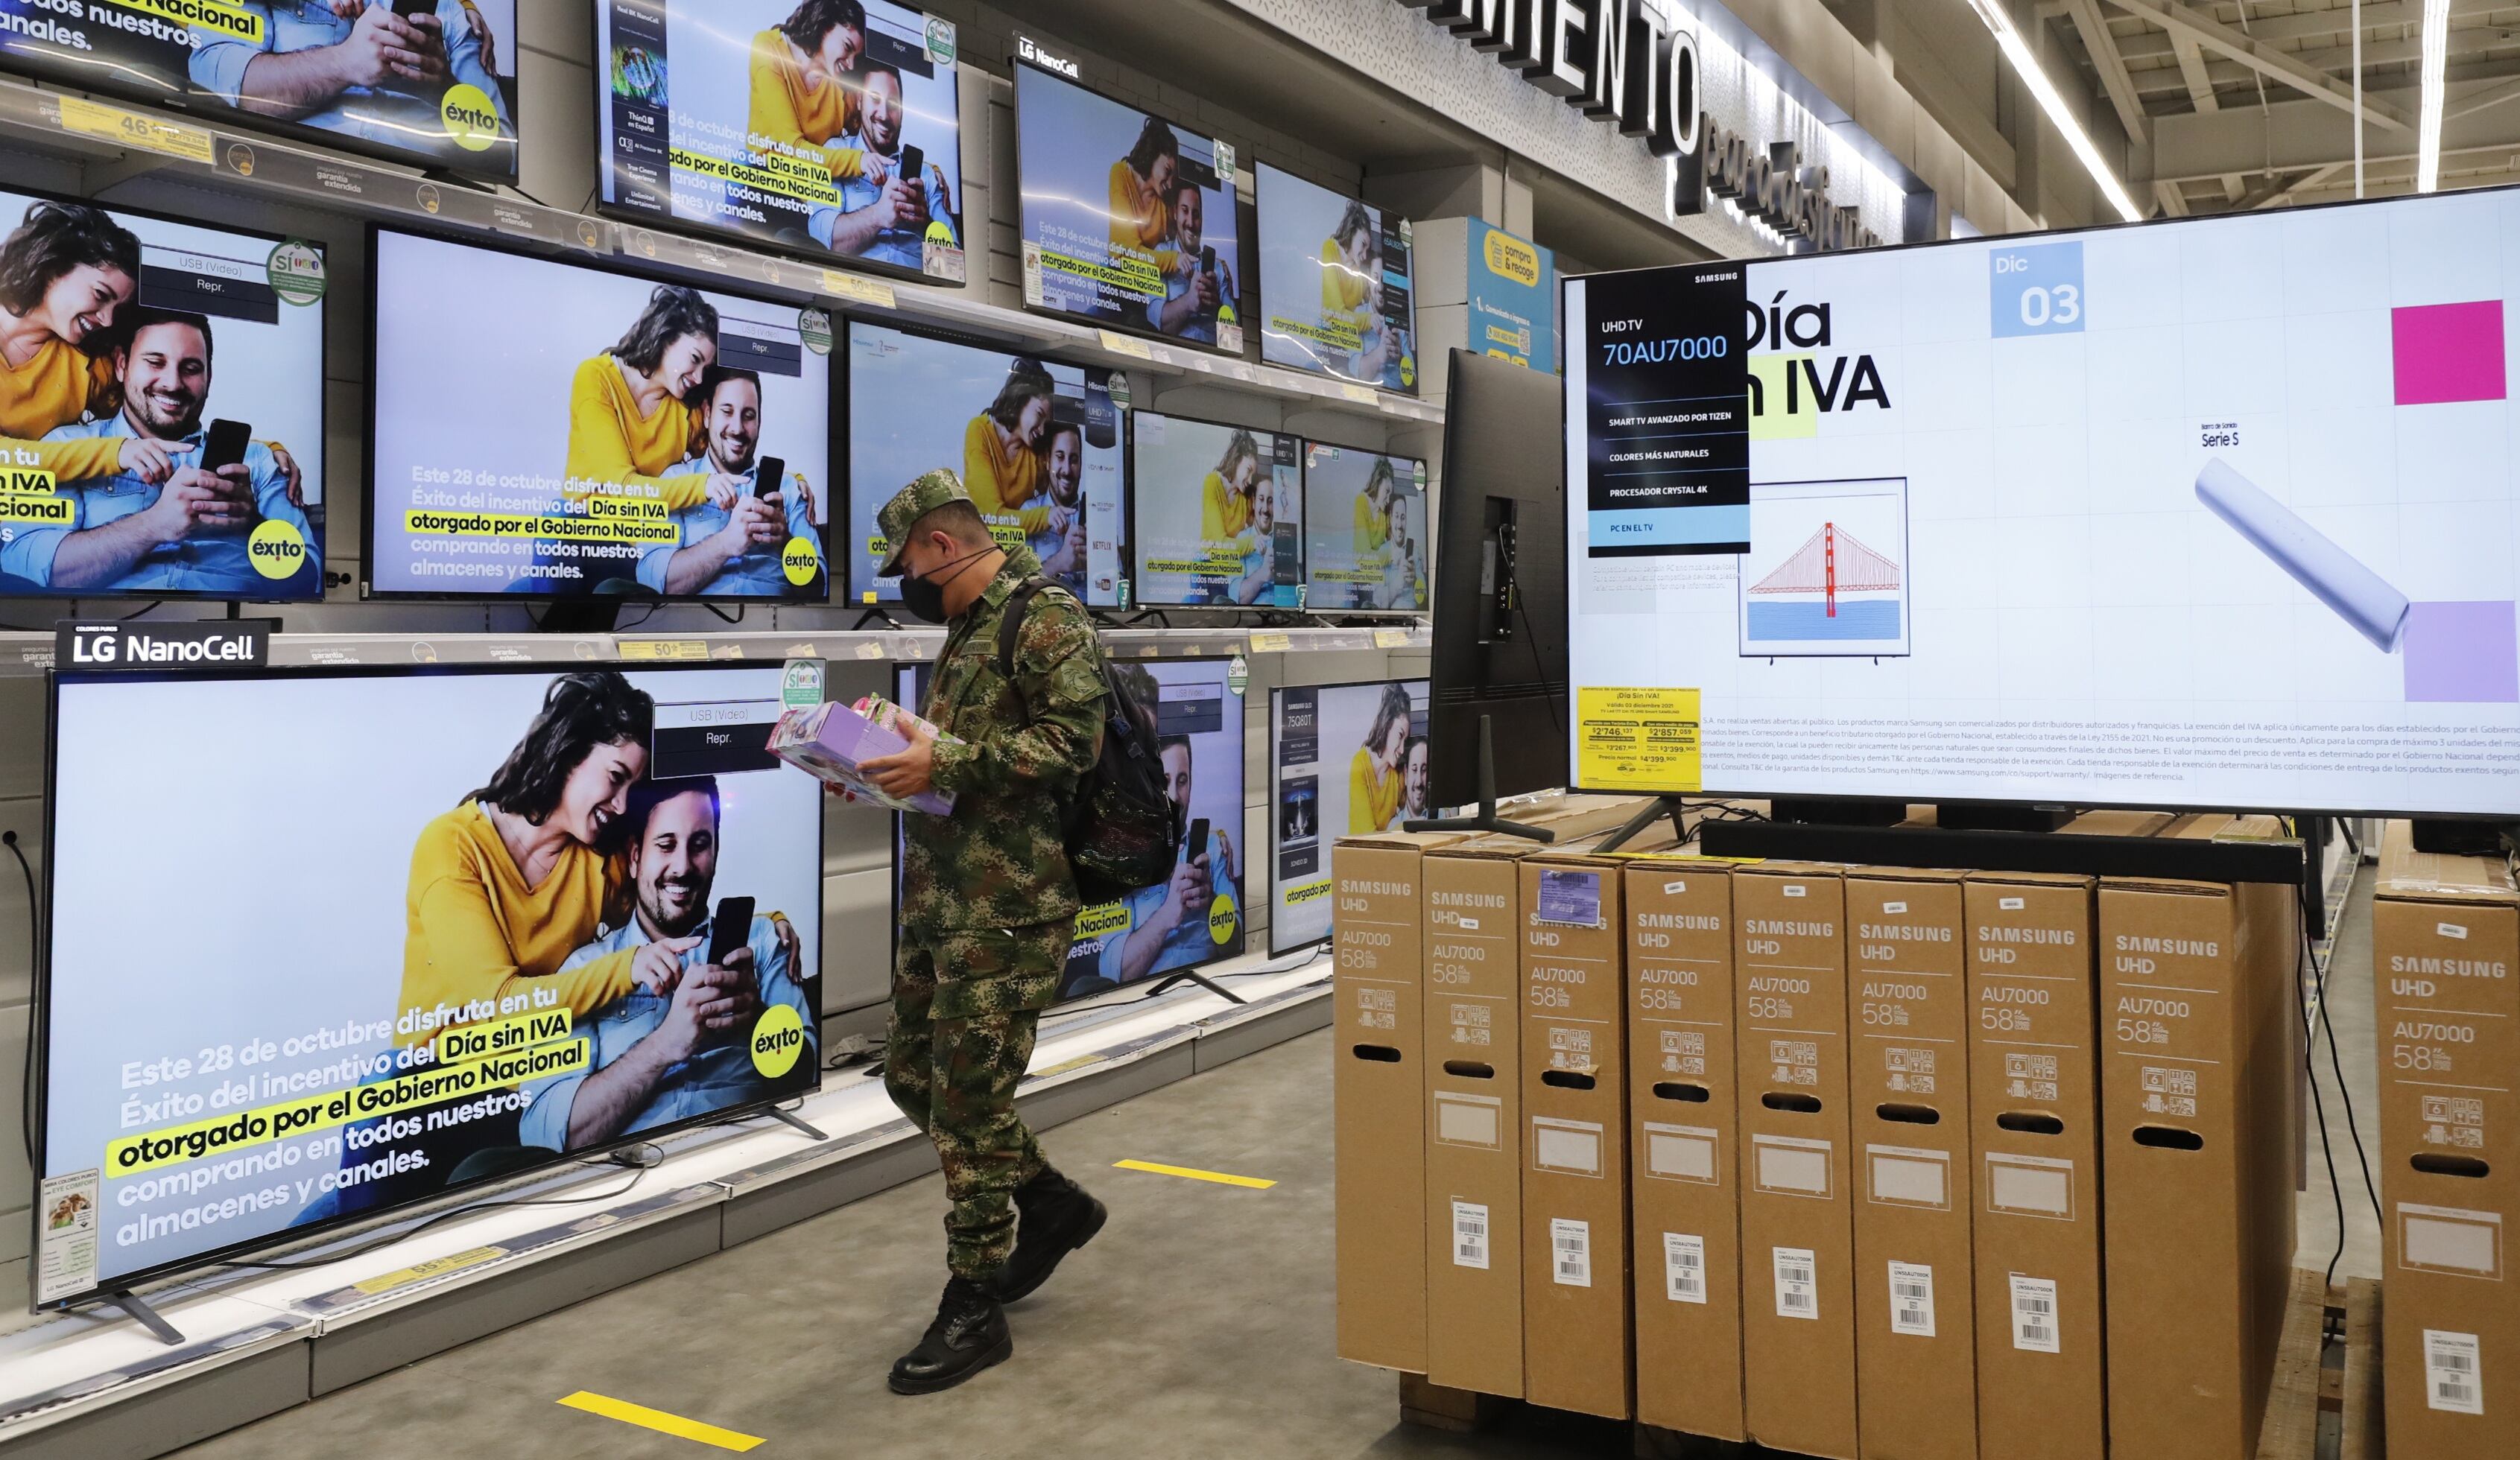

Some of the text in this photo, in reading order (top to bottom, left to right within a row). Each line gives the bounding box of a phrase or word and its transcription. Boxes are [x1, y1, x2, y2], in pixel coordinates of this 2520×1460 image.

[89, 4, 203, 49] nuestros
[151, 0, 256, 36] Nacional
[1019, 41, 1078, 78] LG NanoCell
[446, 103, 496, 131] éxito
[317, 171, 348, 183] garantía
[770, 156, 829, 182] Día sin IVA
[325, 180, 361, 193] extendida
[731, 165, 838, 203] Gobierno Nacional
[716, 202, 767, 223] canales.
[1505, 246, 1530, 264] compra
[179, 256, 243, 279] USB (Video)
[1041, 253, 1164, 293] otorgado Gobierno Nacional
[1123, 260, 1159, 279] Día sin IVA
[1505, 258, 1534, 280] & recoge
[1995, 254, 2028, 275] Dic
[197, 279, 224, 293] Repr.
[1694, 273, 1738, 283] SAMSUNG
[2020, 284, 2080, 327] 03
[1602, 319, 1643, 333] UHD TV
[752, 342, 769, 355] Repr.
[1603, 335, 1727, 366] 70AU7000
[1787, 355, 1891, 415] IVA
[1609, 412, 1732, 426] SMART TV AVANZADO POR TIZEN
[2202, 431, 2238, 447] Serie S
[15, 449, 39, 466] tu
[1609, 449, 1709, 462] COLORES MÁS NATURALES
[12, 472, 51, 492] IVA
[1609, 485, 1708, 497] PROCESADOR CRYSTAL 4K
[592, 501, 666, 518] Día sin IVA
[410, 513, 675, 539] otorgado por Gobierno Nacional
[1610, 524, 1621, 533] PC
[995, 530, 1025, 542] sin IVA
[252, 531, 300, 561] éxito
[1092, 541, 1112, 550] NETFLIX
[519, 562, 583, 580] canales.
[785, 553, 814, 572] éxito
[74, 636, 254, 663] LG NanoCell
[654, 643, 671, 656] 50
[690, 707, 749, 723] USB (Video)
[1288, 714, 1311, 727] 75Q80T
[706, 731, 732, 746] Repr.
[1341, 879, 1411, 896] SAMSUNG
[1431, 892, 1505, 908] SAMSUNG
[1080, 910, 1127, 935] Nacional
[1211, 913, 1234, 929] éxito
[1431, 910, 1460, 924] UHD
[1638, 913, 1720, 930] SAMSUNG
[1746, 919, 1833, 937] SAMSUNG
[1861, 924, 1951, 943] SAMSUNG
[1978, 926, 2075, 945] SAMSUNG
[1341, 931, 1391, 946] AU7000
[1530, 932, 1560, 947] UHD
[1638, 933, 1670, 948] UHD
[2115, 934, 2218, 958] SAMSUNG
[1433, 945, 1485, 961] AU7000
[1861, 945, 1896, 961] UHD
[2116, 956, 2155, 974] UHD
[2391, 956, 2507, 979] SAMSUNG
[1530, 967, 1586, 984] AU7000
[1748, 977, 1810, 994] AU7000
[2392, 979, 2436, 997] UHD
[1981, 986, 2049, 1006] AU7000
[2118, 997, 2189, 1018] AU7000
[121, 986, 557, 1090] Este 28 de octubre disfruta en tu
[755, 1027, 801, 1056] éxito
[2393, 1022, 2475, 1043] AU7000
[120, 1013, 568, 1129] Éxito del incentivo del Día sin IVA
[118, 1041, 583, 1167] otorgado por el Gobierno Nacional
[117, 1089, 532, 1207] comprando en todos nuestros
[116, 1149, 430, 1247] almacenes y canales.
